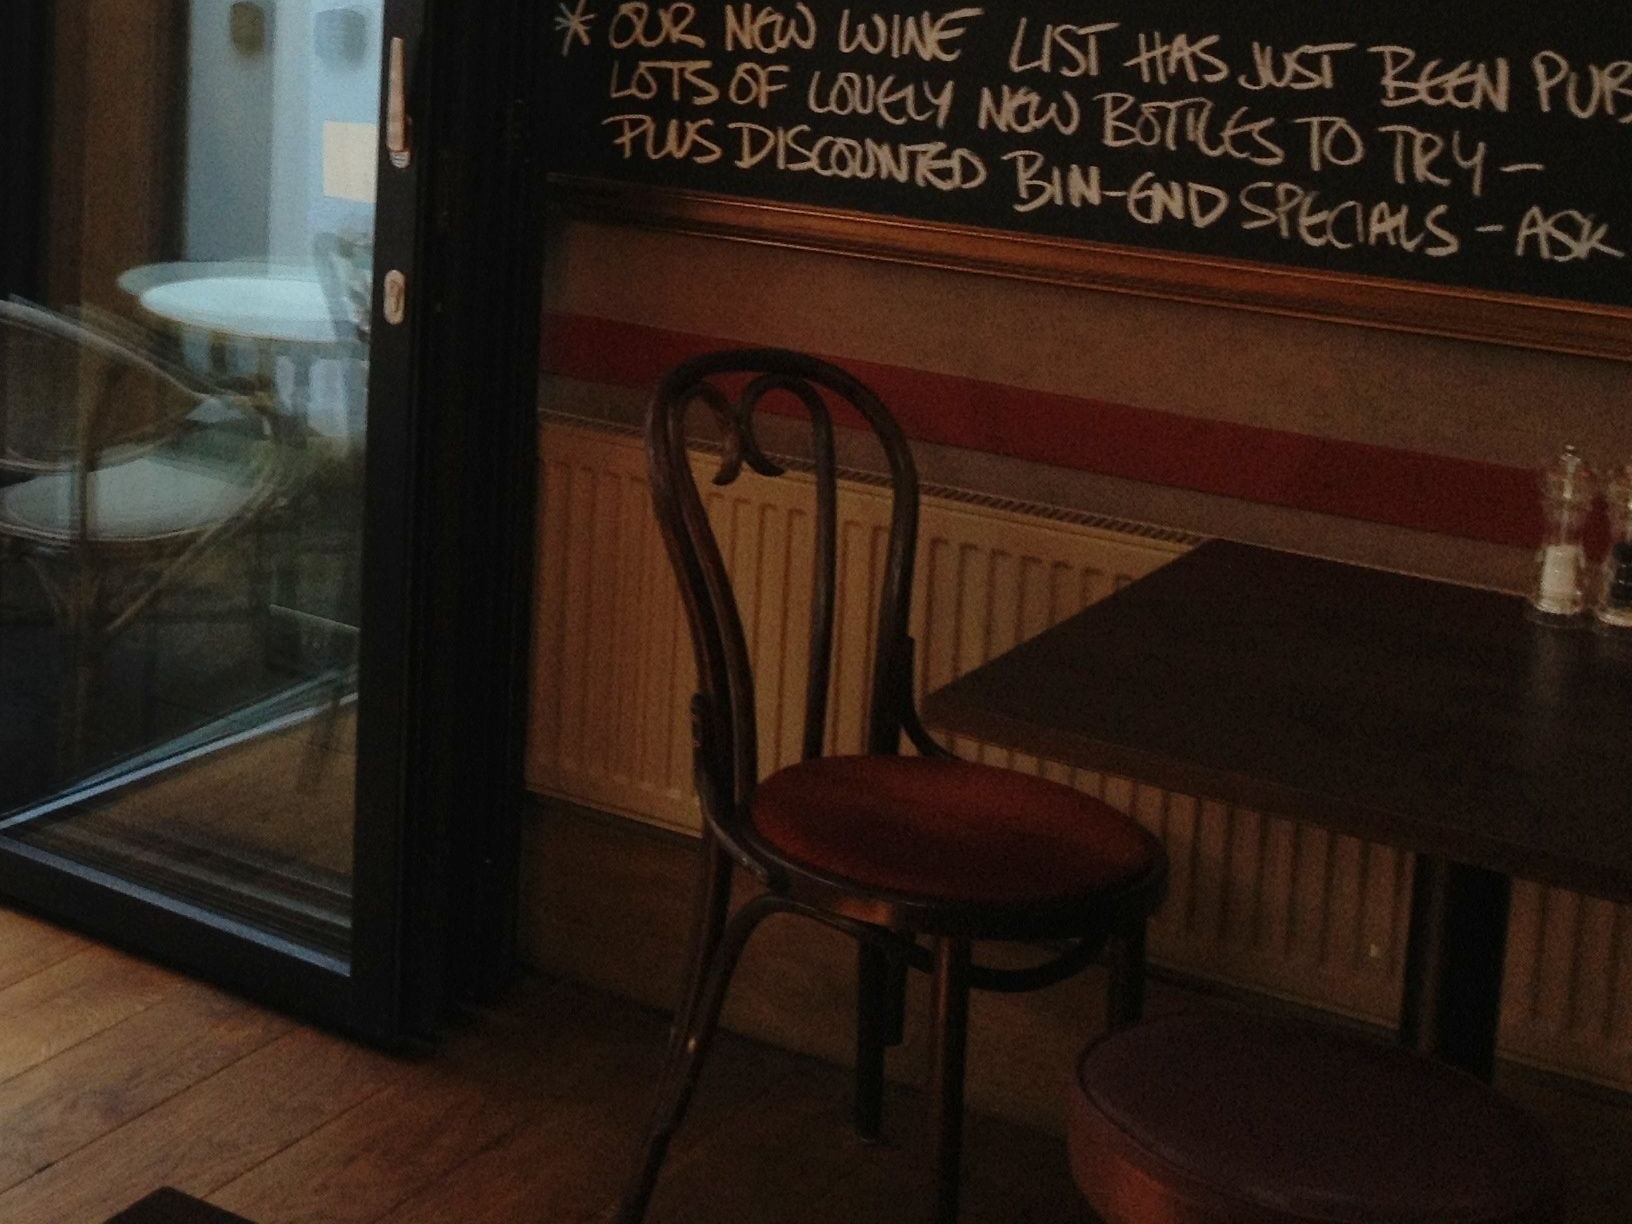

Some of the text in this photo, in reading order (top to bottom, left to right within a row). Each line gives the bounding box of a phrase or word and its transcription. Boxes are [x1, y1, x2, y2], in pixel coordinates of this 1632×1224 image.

[608, 2, 706, 48] OUR
[724, 2, 817, 53] NEW
[838, 7, 983, 62] WINE
[1009, 16, 1120, 77] LIST
[1124, 32, 1229, 84] HAS
[1238, 41, 1357, 90] JUST
[1368, 46, 1509, 112] BEEN
[609, 61, 720, 105] LOTS
[728, 62, 791, 109] OF
[807, 71, 956, 128] LOVELY
[978, 85, 1079, 135] NEW
[1094, 92, 1285, 165] BOTTLES
[1294, 116, 1364, 171] TO
[602, 114, 722, 164] PLUS
[728, 122, 988, 190] DISCOUNTED
[1002, 150, 1228, 228] BIN-END
[1240, 181, 1461, 256] SPECIALS
[1515, 205, 1625, 263] ASK
